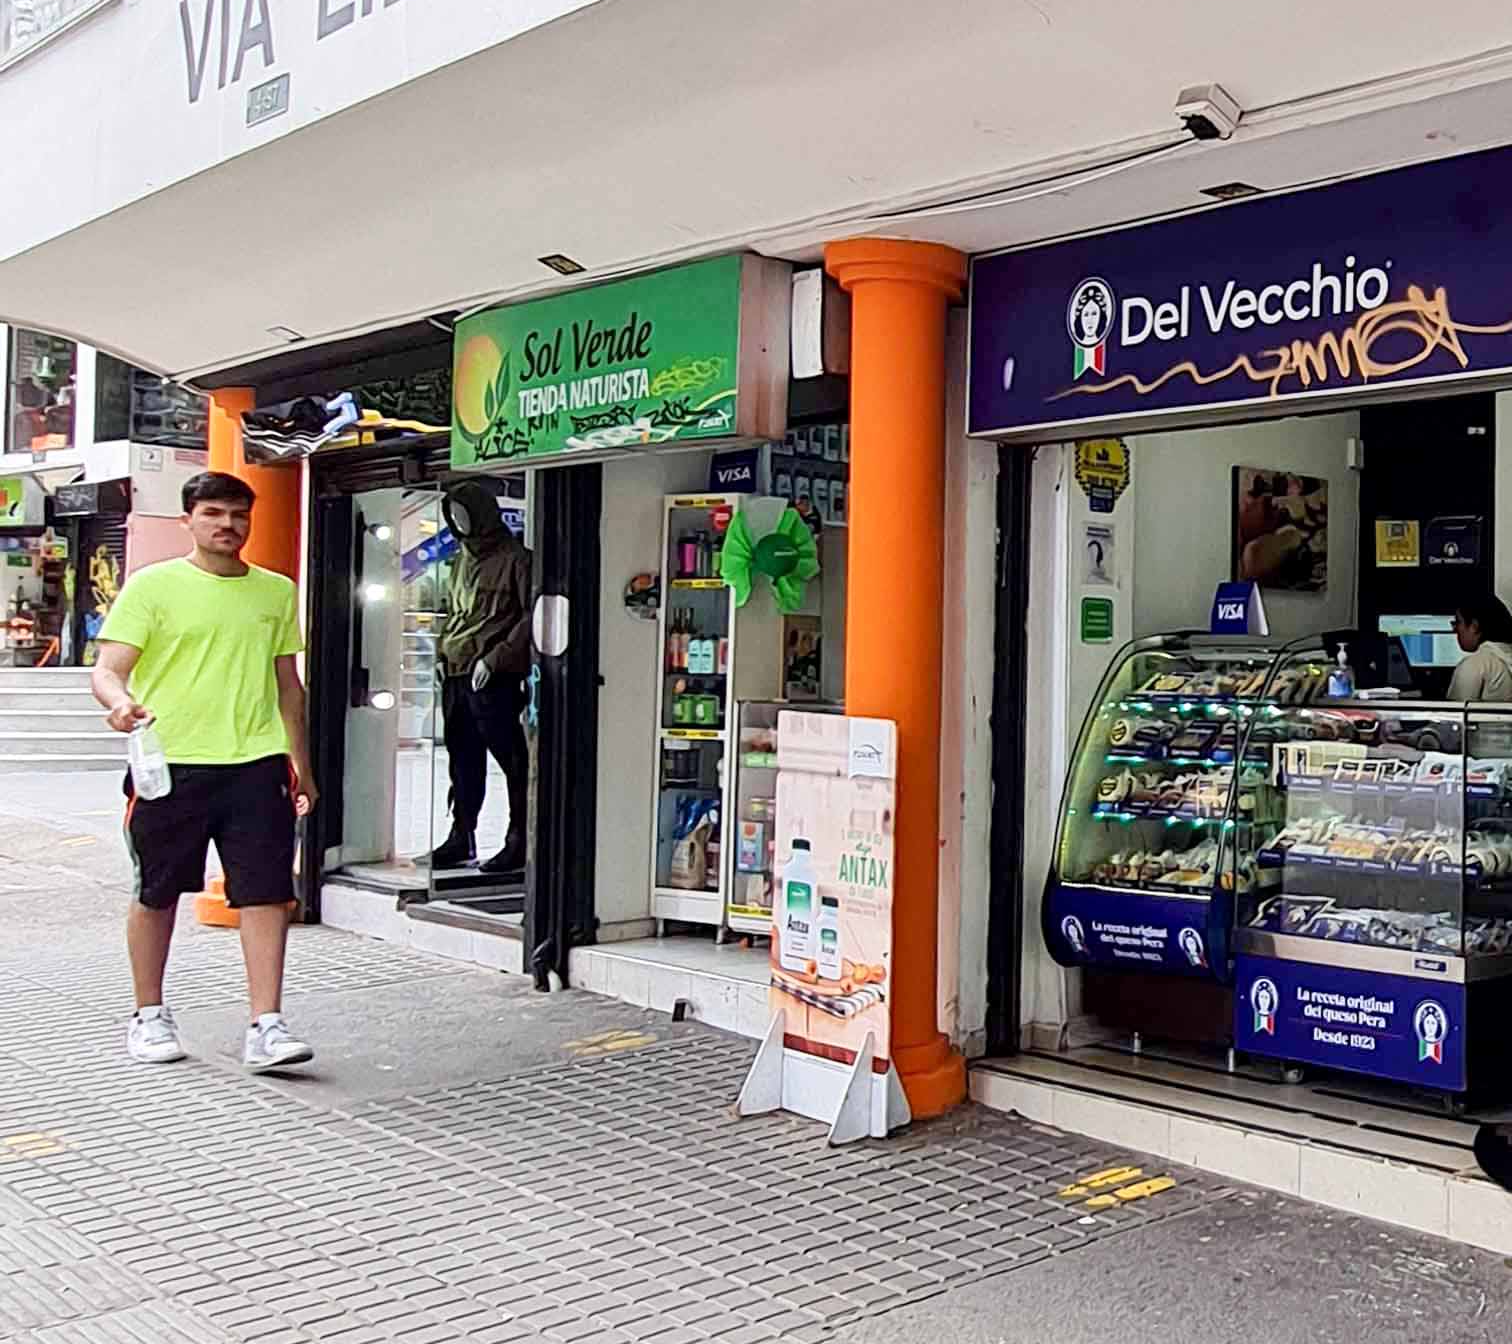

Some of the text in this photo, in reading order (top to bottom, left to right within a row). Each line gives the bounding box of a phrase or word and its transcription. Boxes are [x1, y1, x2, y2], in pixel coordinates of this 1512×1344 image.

[1119, 255, 1390, 348] Del Vecchio
[518, 311, 654, 383] Sol Verde
[517, 385, 569, 420] TIENDA
[569, 367, 650, 410] NATURISTA
[716, 465, 752, 484] VISA
[1217, 602, 1245, 621] VISA
[838, 853, 889, 889] ANTAX
[1296, 986, 1395, 1016] La receta original
[1303, 1003, 1387, 1029] del queso Pera
[1312, 1027, 1377, 1051] Desde 1923
